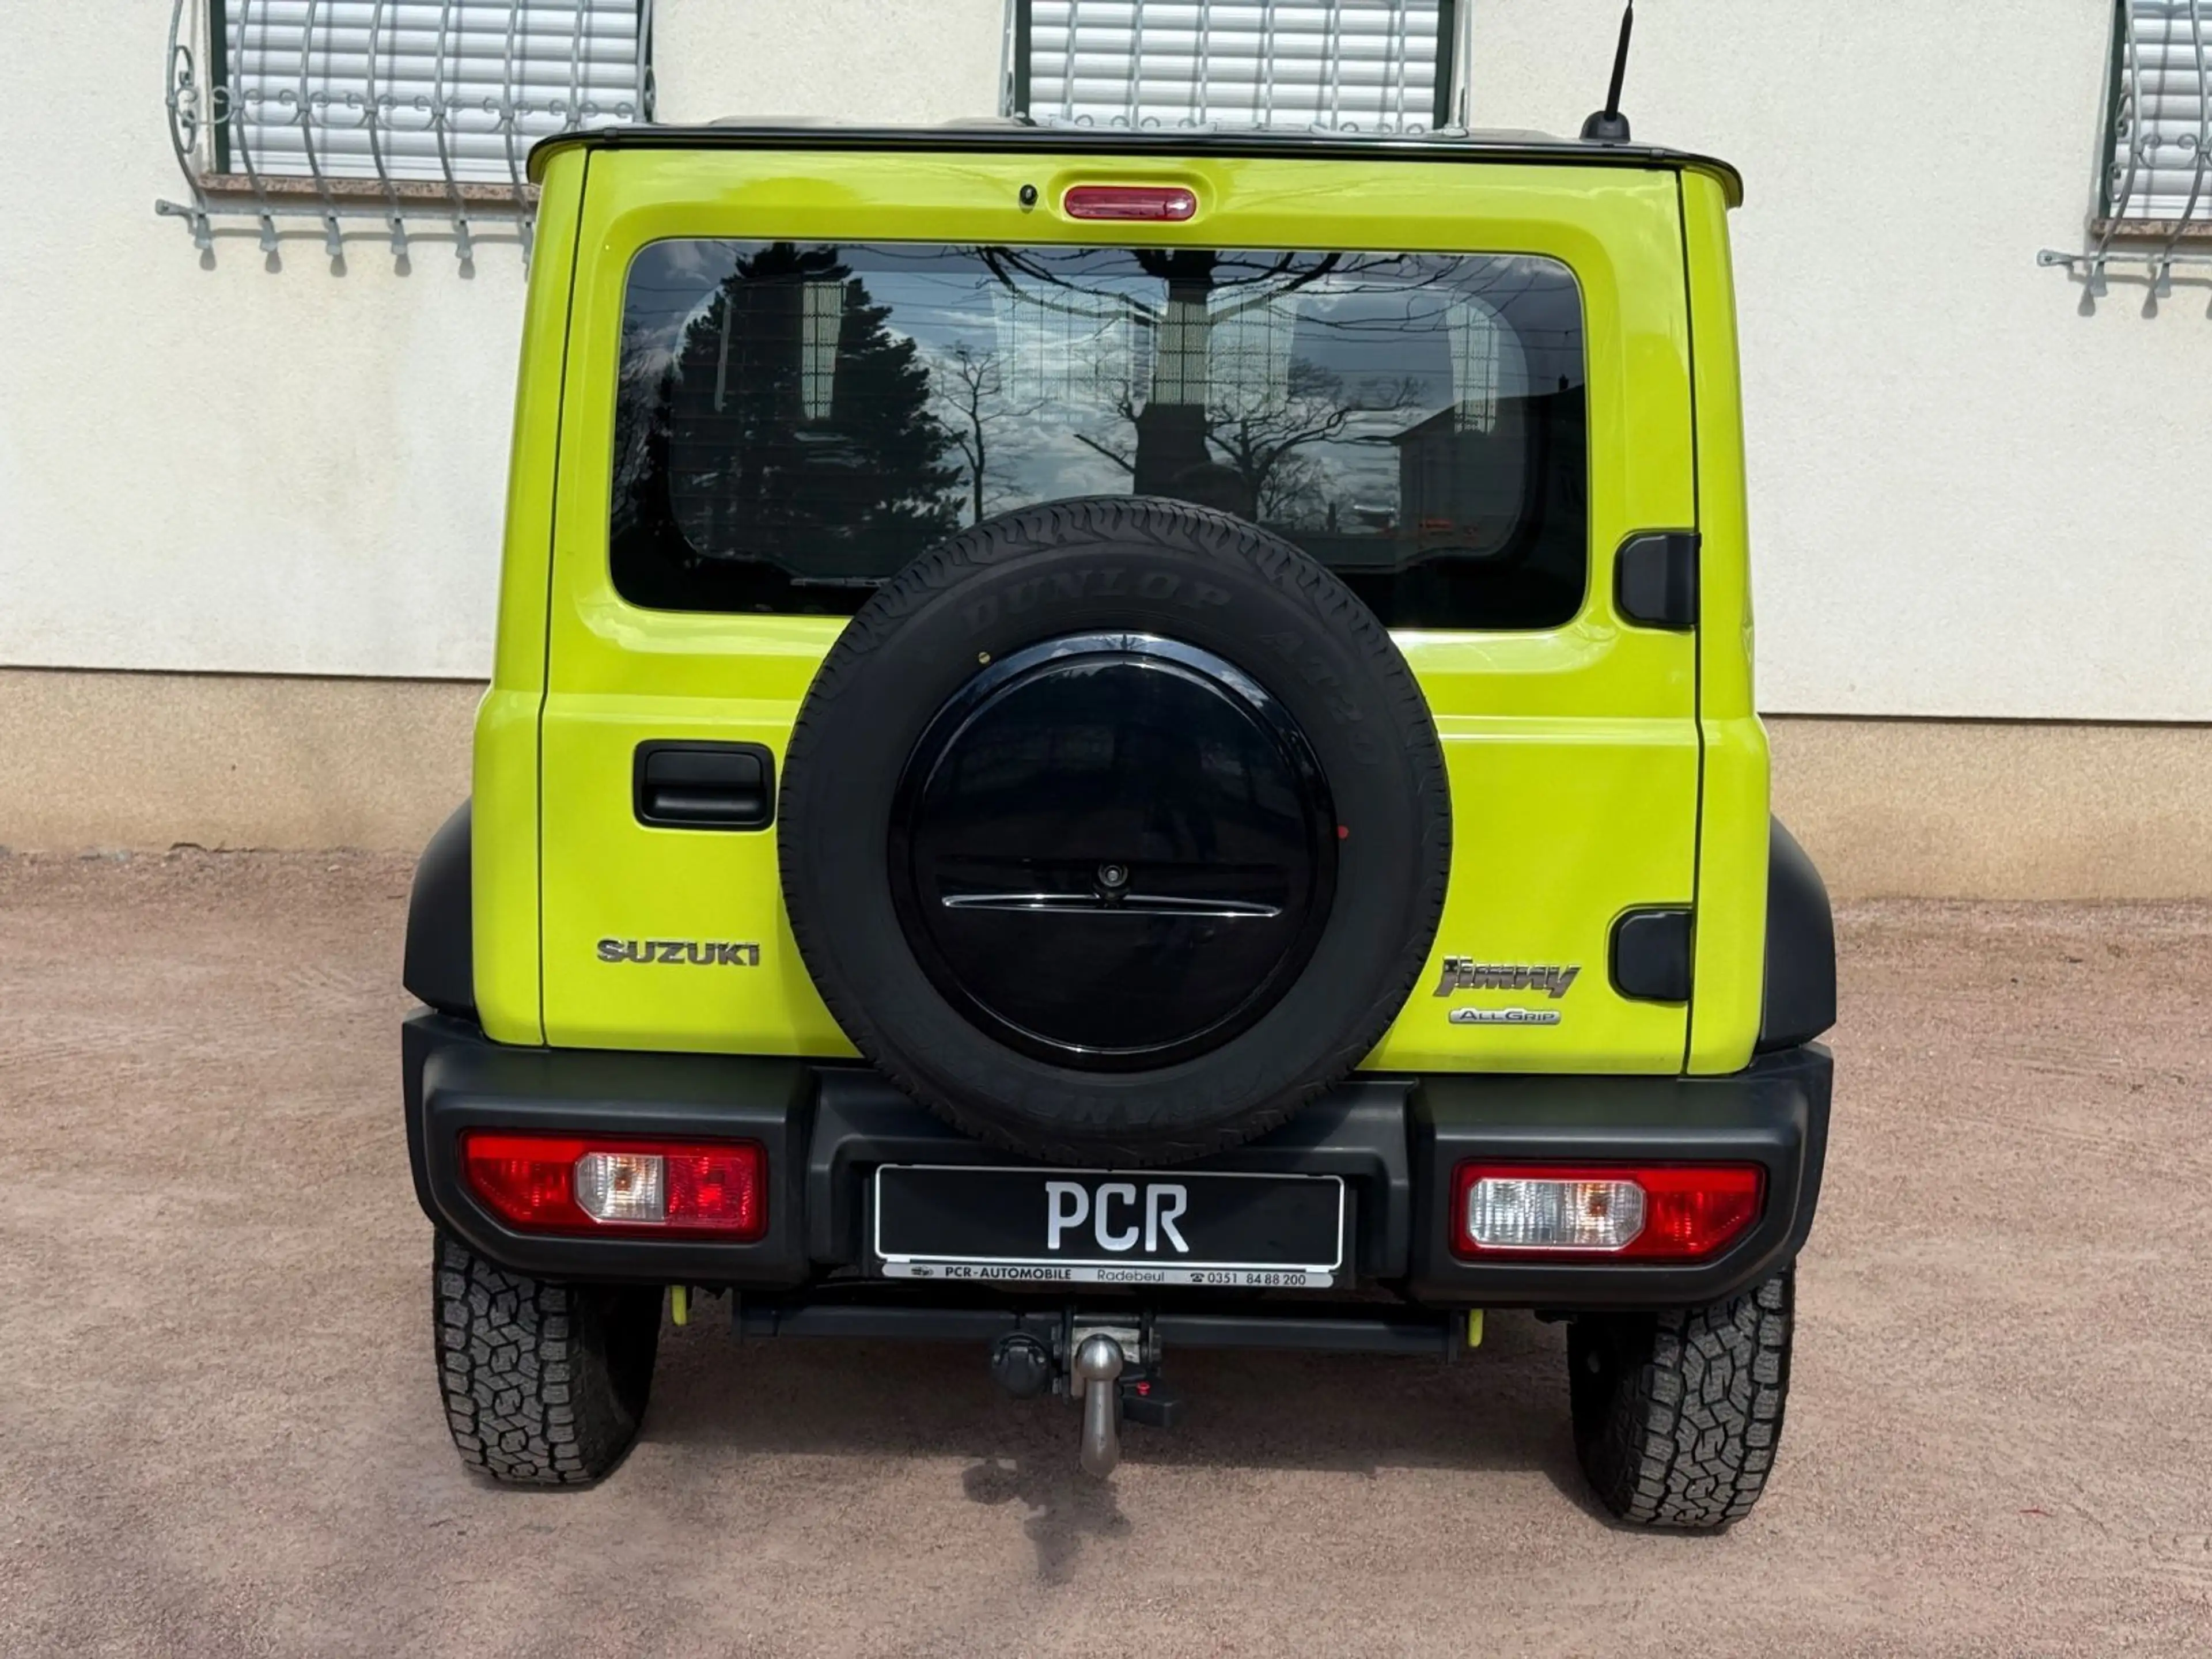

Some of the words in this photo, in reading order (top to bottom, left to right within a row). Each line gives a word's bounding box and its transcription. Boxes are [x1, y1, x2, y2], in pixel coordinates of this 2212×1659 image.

[961, 567, 1232, 634] DUNLOP
[597, 939, 760, 967] SUZUKI
[1433, 956, 1581, 998] Jimny
[1046, 1181, 1190, 1252] PCR
[1097, 1269, 1165, 1282] Radebeul
[1207, 1273, 1238, 1285] 0351
[1283, 1274, 1306, 1286] 200
